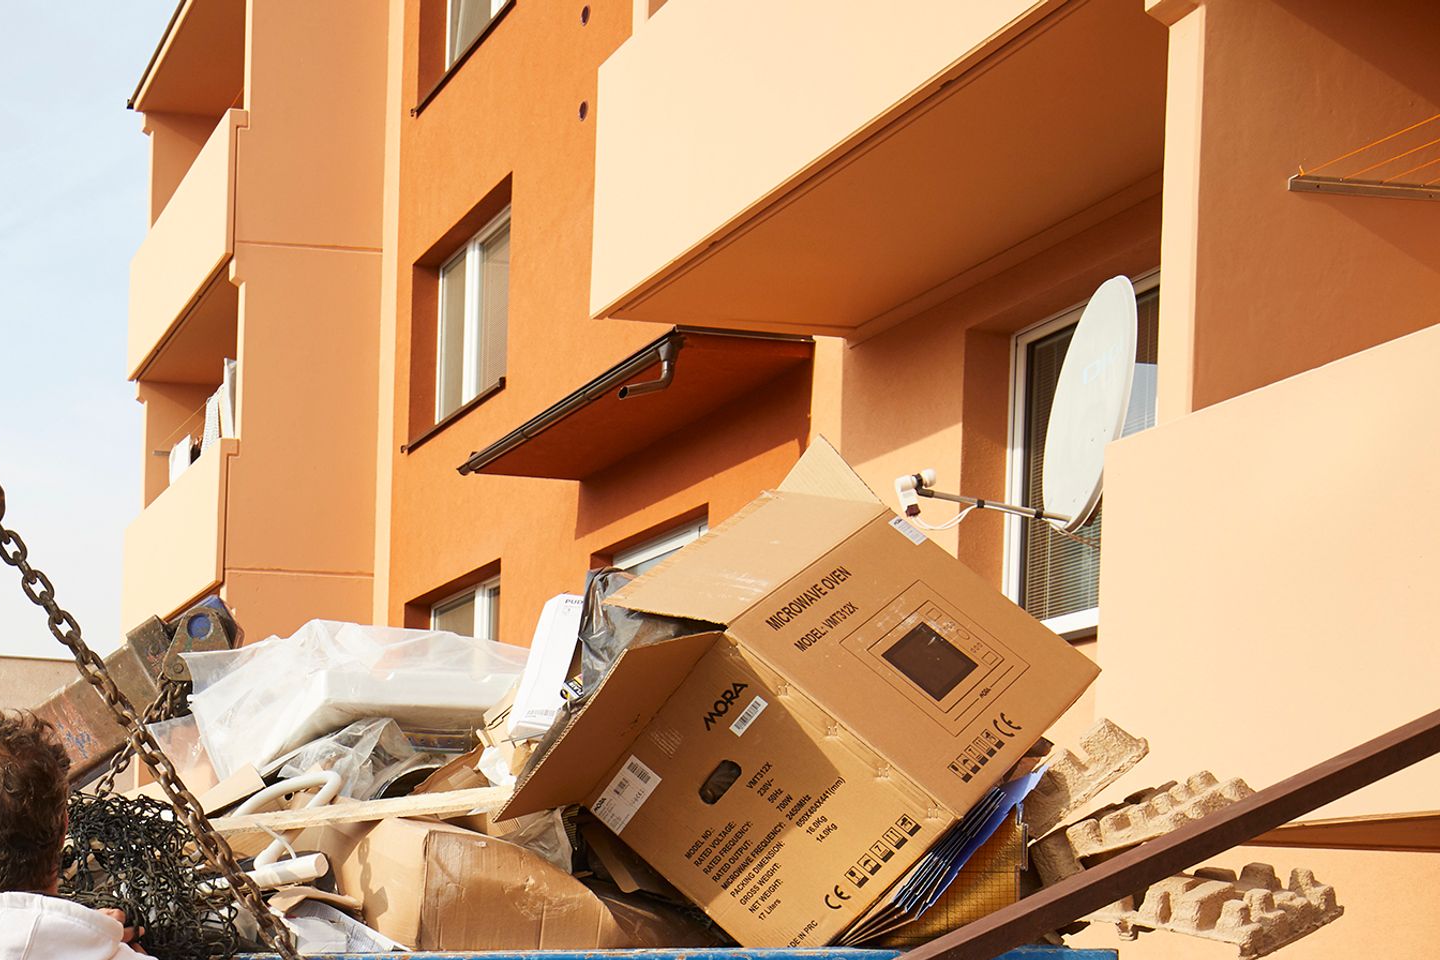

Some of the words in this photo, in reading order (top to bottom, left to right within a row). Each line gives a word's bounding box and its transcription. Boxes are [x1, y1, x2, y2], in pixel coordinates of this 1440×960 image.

[765, 584, 827, 631] MICROWAVE
[825, 566, 852, 591] OVEN
[794, 622, 827, 652] MODEL:
[822, 601, 859, 630] VMT312X
[703, 682, 749, 731] MORA
[685, 840, 704, 859] MODEL
[746, 762, 773, 789] VMT312X
[703, 855, 721, 875] RATED
[719, 821, 753, 857] FREQUENCY:
[767, 788, 784, 803] 50Hz
[712, 863, 731, 882] RATED
[728, 840, 753, 865] OUTPUT:
[776, 794, 793, 812] 700W
[721, 856, 753, 890] MICROWAVE
[750, 822, 786, 858] FREQUENCY:
[786, 794, 812, 821] 2450MHz
[694, 847, 712, 867] RATED
[710, 821, 737, 849] VOLTAGE:
[730, 872, 755, 897] PACKING
[753, 841, 785, 873] DIMENSION:
[740, 886, 760, 905] GROSS
[760, 862, 781, 887] WEIGHT:
[806, 815, 828, 835] 16.0Kg
[749, 900, 761, 913] NET
[760, 879, 783, 902] WEIGHT:
[816, 823, 838, 842] 14.0Kg
[758, 912, 766, 920] 17
[767, 899, 781, 915] Liters
[803, 920, 819, 934] PRC
